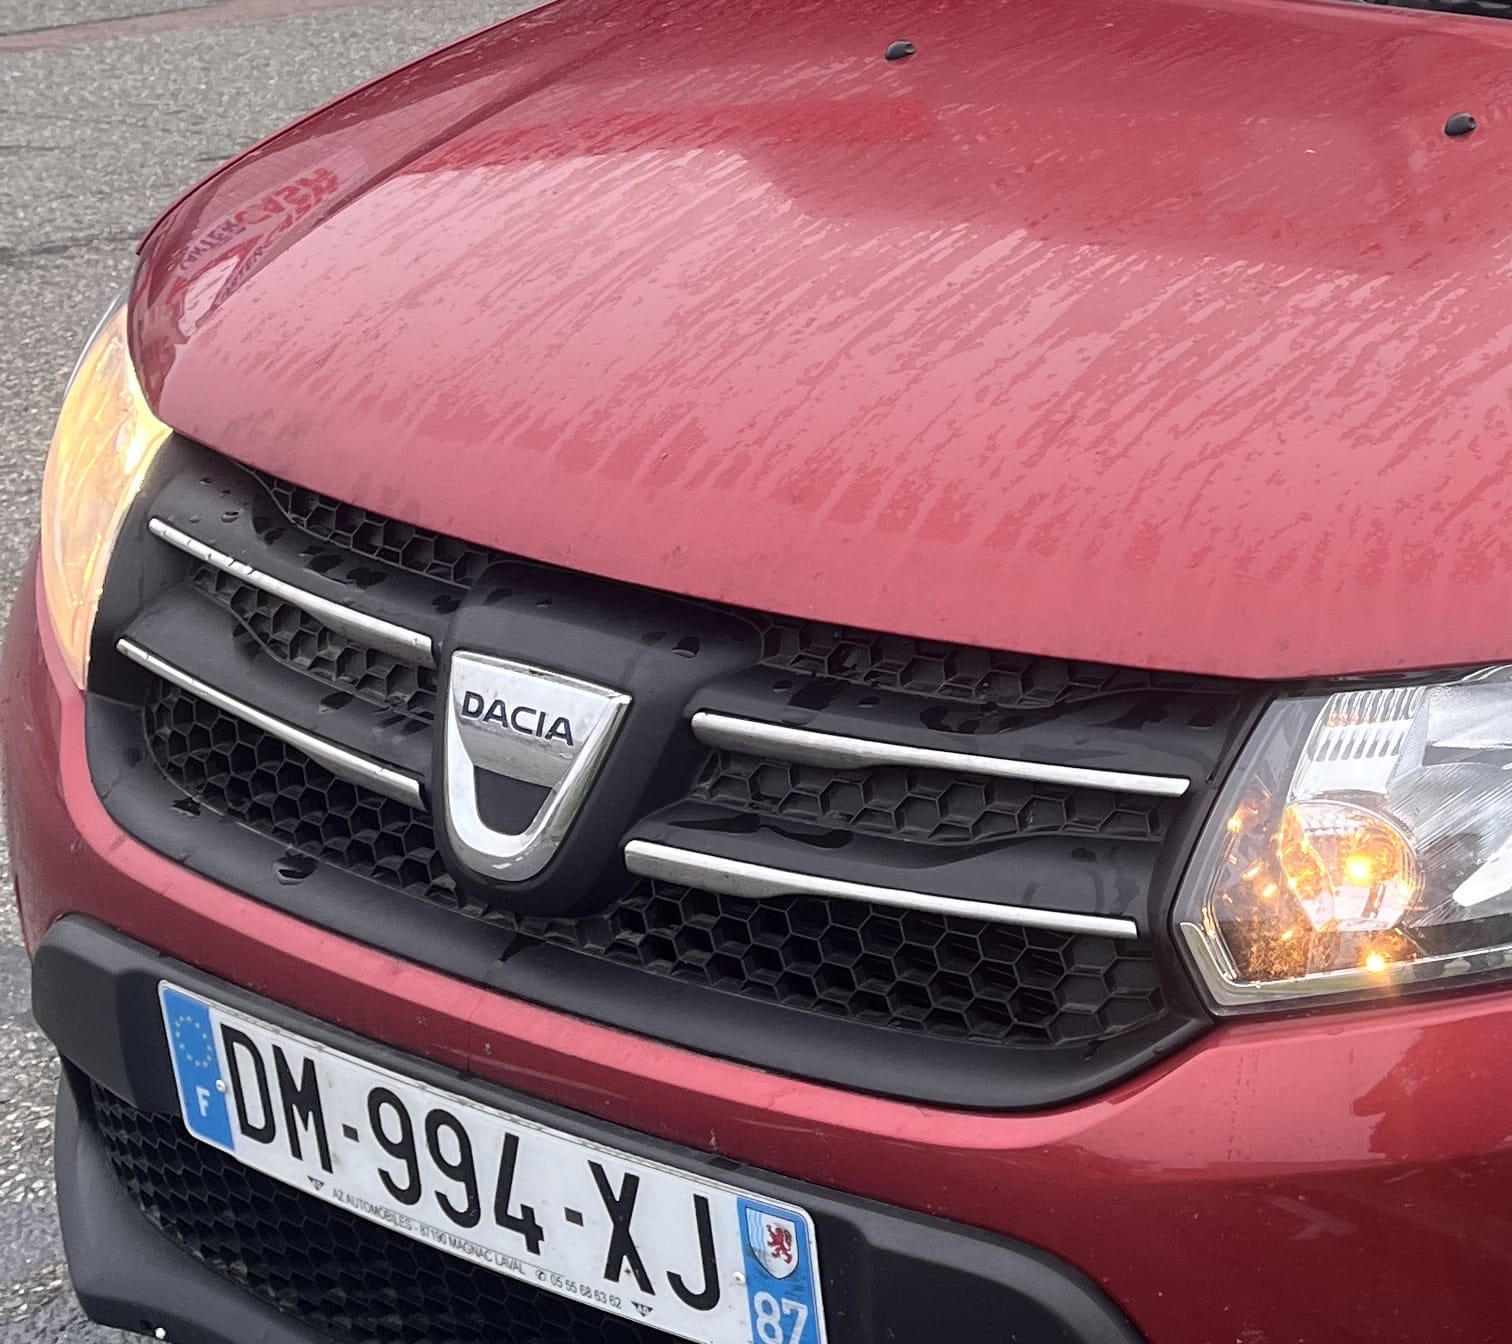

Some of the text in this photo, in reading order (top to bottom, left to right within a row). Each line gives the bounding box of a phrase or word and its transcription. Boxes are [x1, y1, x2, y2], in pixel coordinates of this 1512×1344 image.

[461, 690, 574, 747] DACIA
[195, 1085, 210, 1117] F
[220, 1022, 721, 1312] DM-994-XJ
[345, 1194, 413, 1232] AUTOMOBILES
[448, 1234, 493, 1262] MAGNAC
[494, 1253, 526, 1276] LAVAL
[550, 1273, 563, 1289] 05
[565, 1279, 578, 1294] 55
